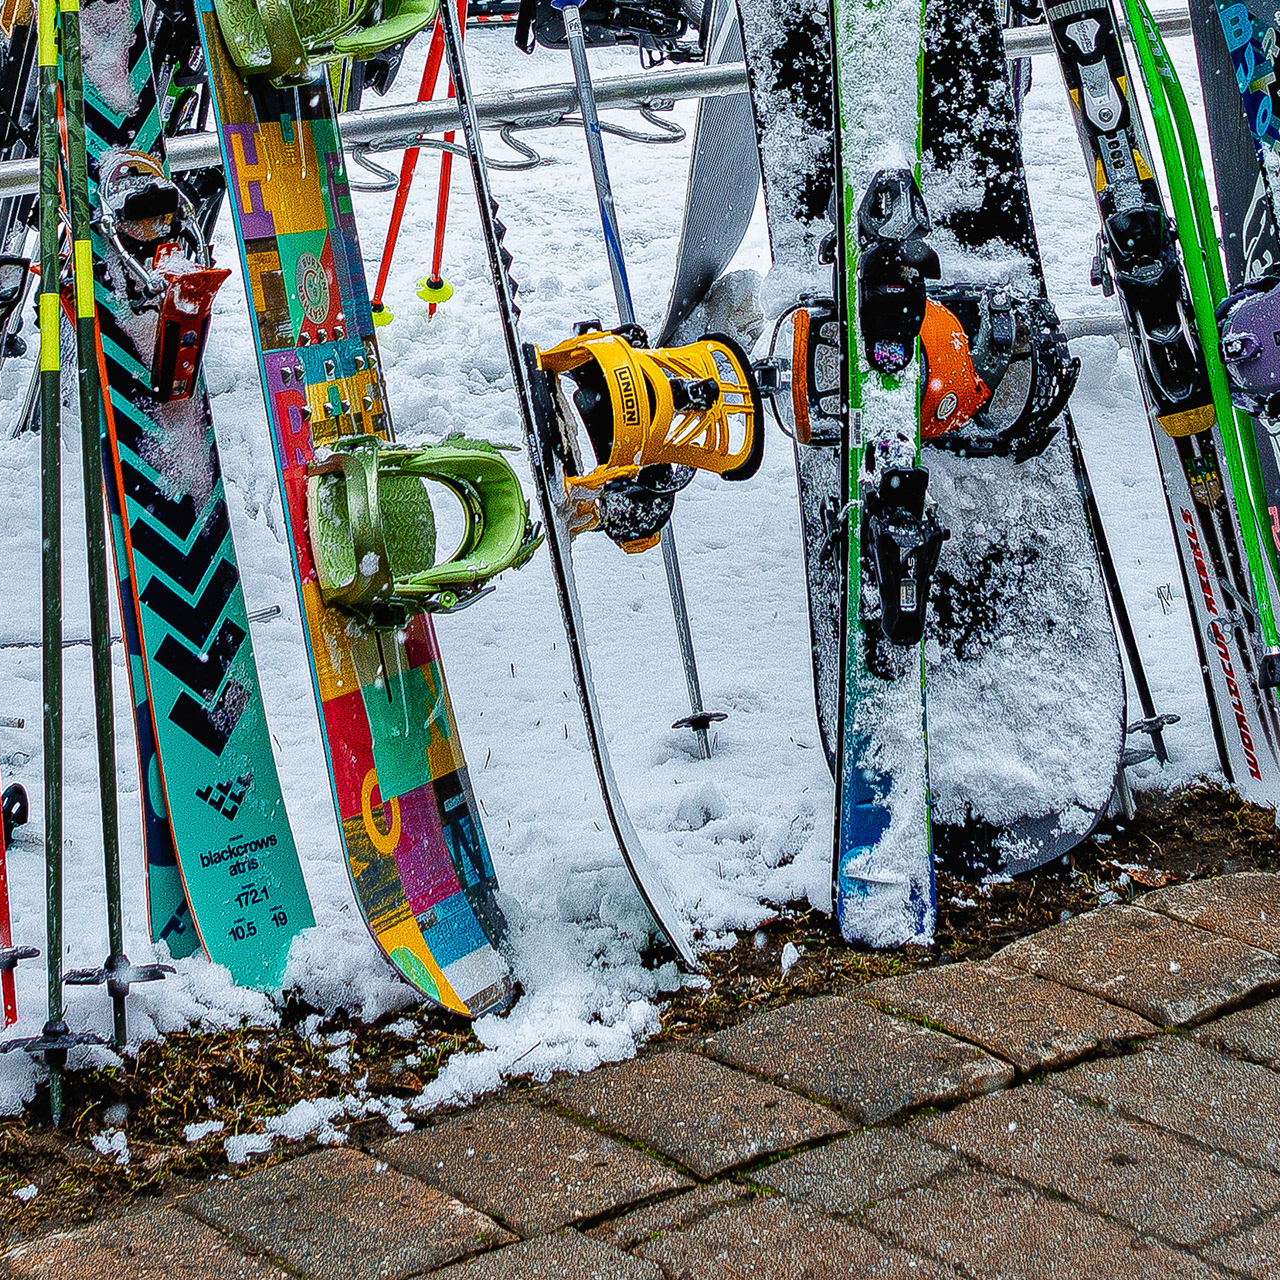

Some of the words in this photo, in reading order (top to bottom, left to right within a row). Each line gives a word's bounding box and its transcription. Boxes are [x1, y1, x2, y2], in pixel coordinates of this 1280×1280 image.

[618, 370, 637, 422] UNION
[1180, 507, 1218, 615] REBELS
[1208, 622, 1262, 781] WORLDCUP
[200, 832, 278, 869] blackcrows
[228, 855, 260, 878] atris
[228, 921, 257, 942] 10.5
[270, 911, 288, 928] 19
